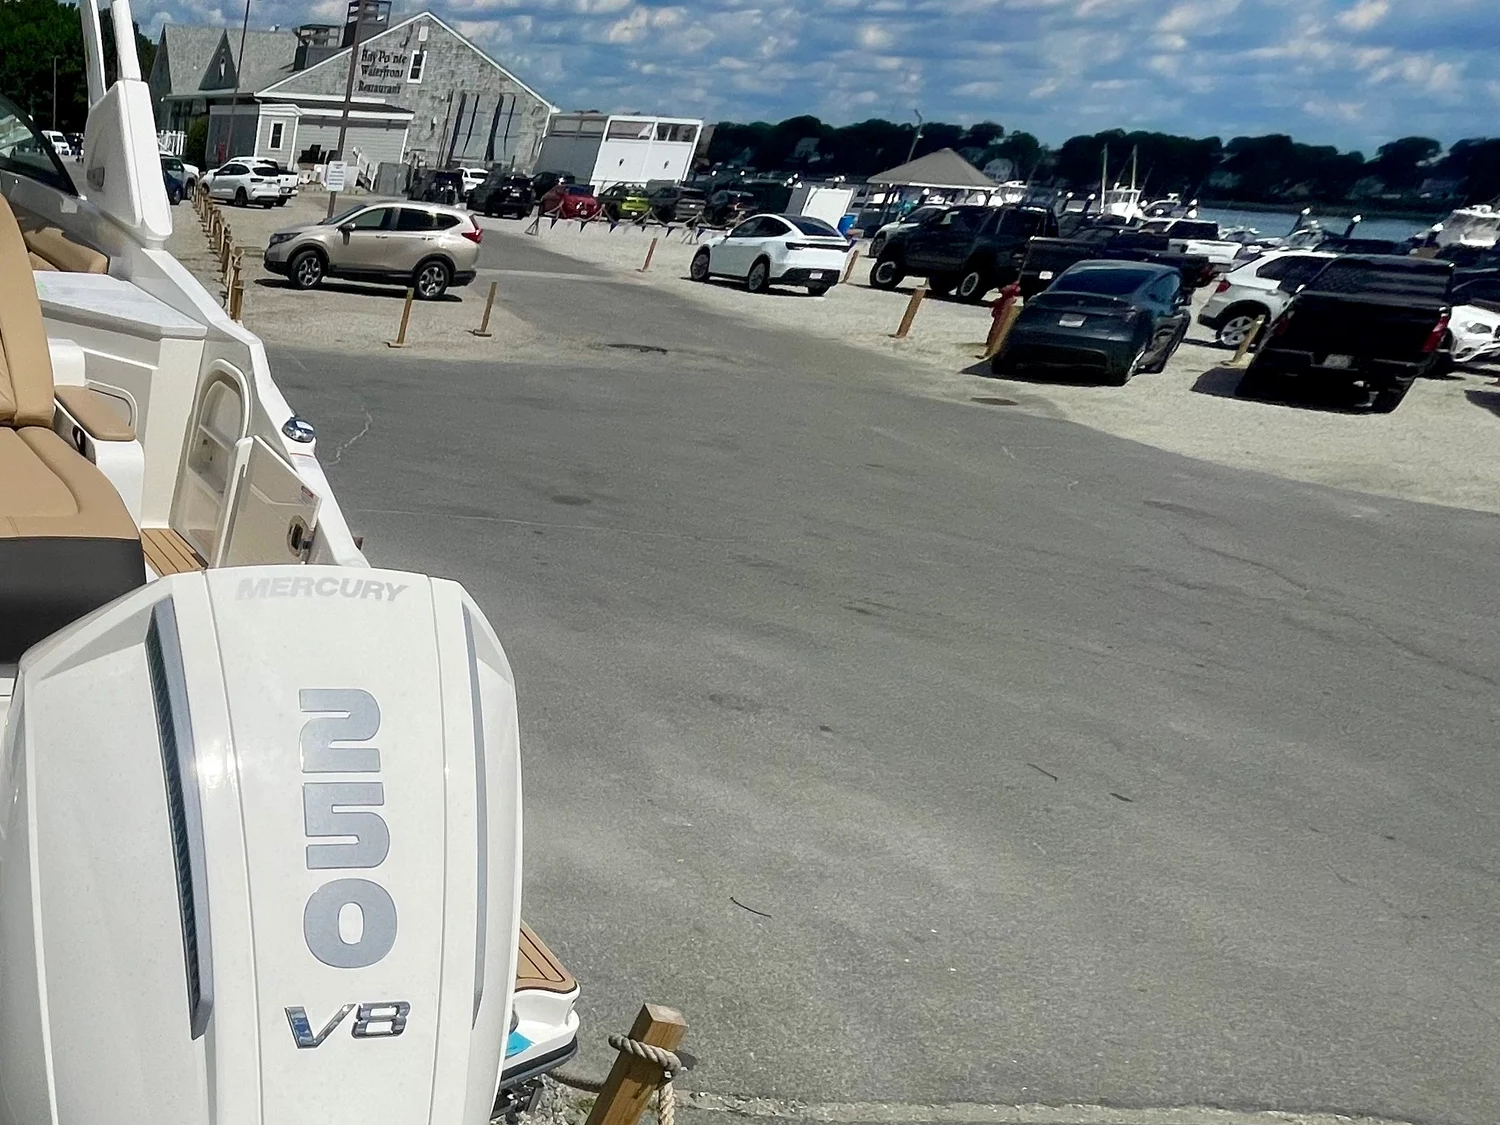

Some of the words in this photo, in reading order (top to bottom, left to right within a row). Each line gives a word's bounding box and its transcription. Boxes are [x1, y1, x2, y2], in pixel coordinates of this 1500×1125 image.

[361, 64, 404, 80] Waterfront
[358, 80, 402, 94] Restaurant
[235, 576, 410, 602] MERCURY
[298, 688, 398, 969] 250
[284, 1000, 411, 1050] V8
